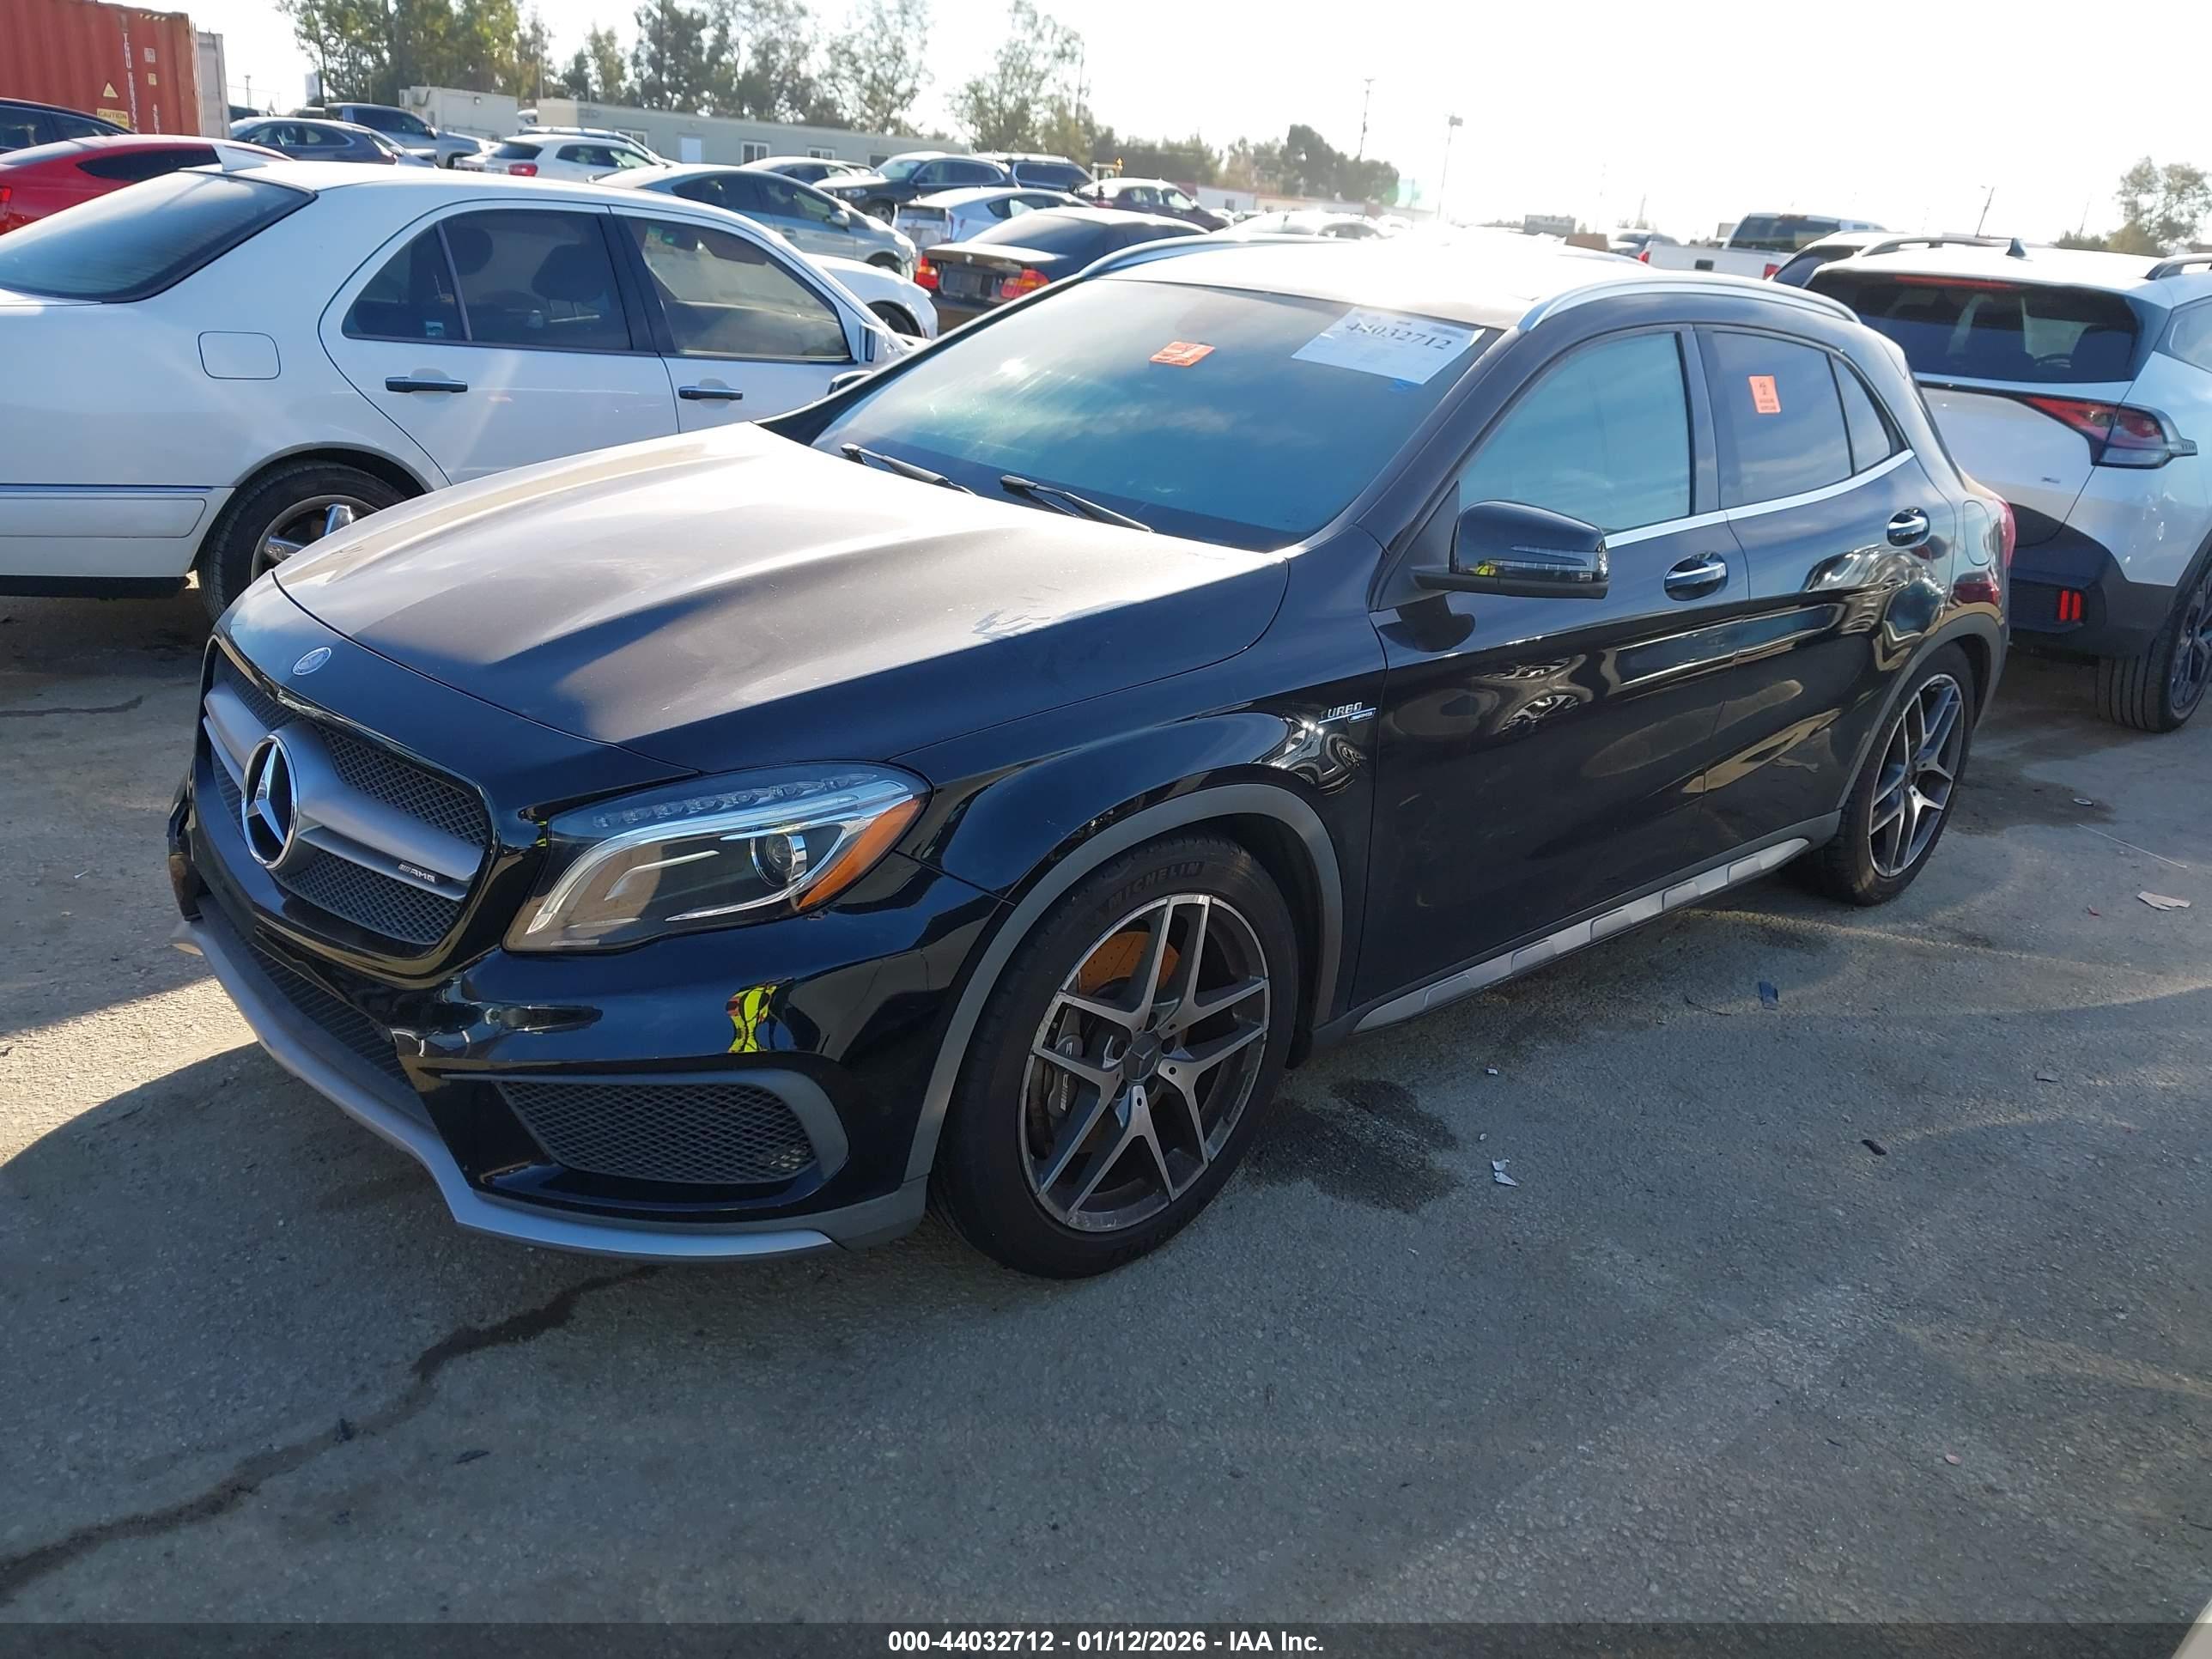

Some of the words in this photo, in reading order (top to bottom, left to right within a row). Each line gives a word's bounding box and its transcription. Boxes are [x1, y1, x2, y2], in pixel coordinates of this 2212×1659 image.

[1320, 702, 1363, 719] TURBO
[408, 866, 435, 884] AMG
[1108, 861, 1204, 908] MICHELIN
